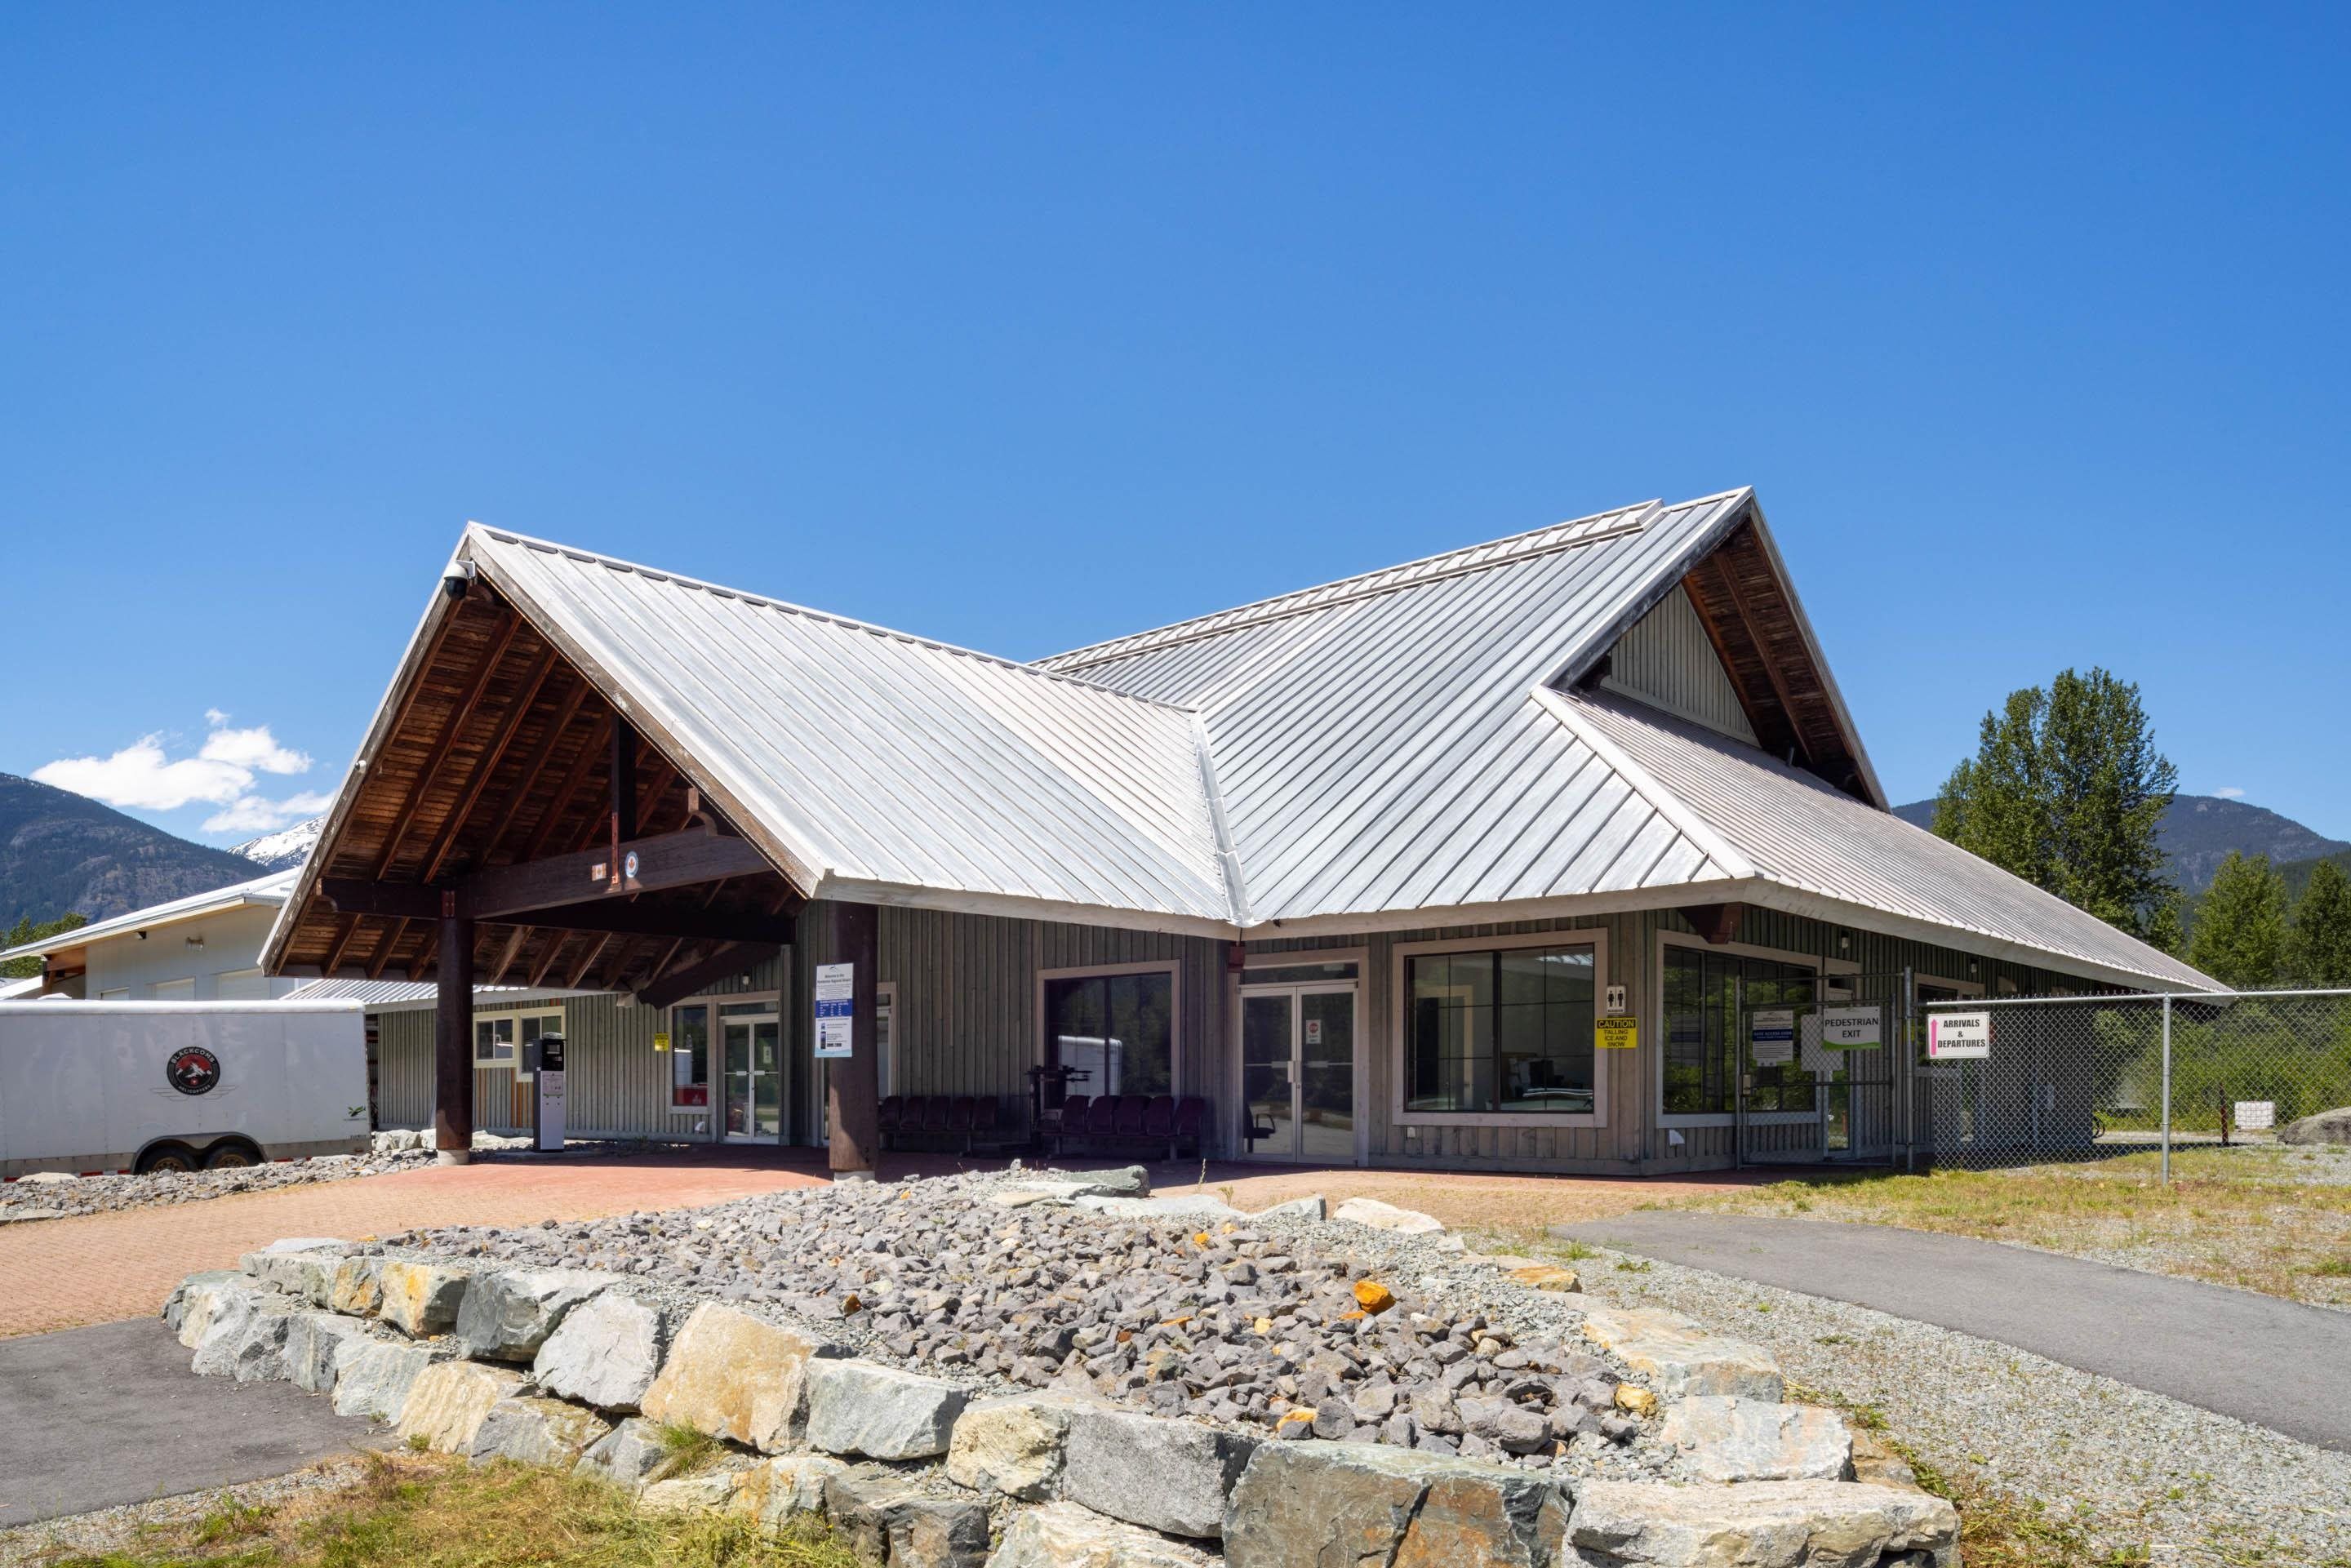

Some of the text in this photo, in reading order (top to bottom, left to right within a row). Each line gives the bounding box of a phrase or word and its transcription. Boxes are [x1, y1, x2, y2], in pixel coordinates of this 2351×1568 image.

[1824, 1017, 1879, 1028] PEDESTRIAN
[1943, 1019, 1980, 1028] ARRIVALS
[1842, 1029, 1861, 1038] EXIT
[1957, 1030, 1963, 1038] &
[1937, 1038, 1986, 1048] DEPARTURES
[170, 1048, 216, 1064] BLACKCOMB
